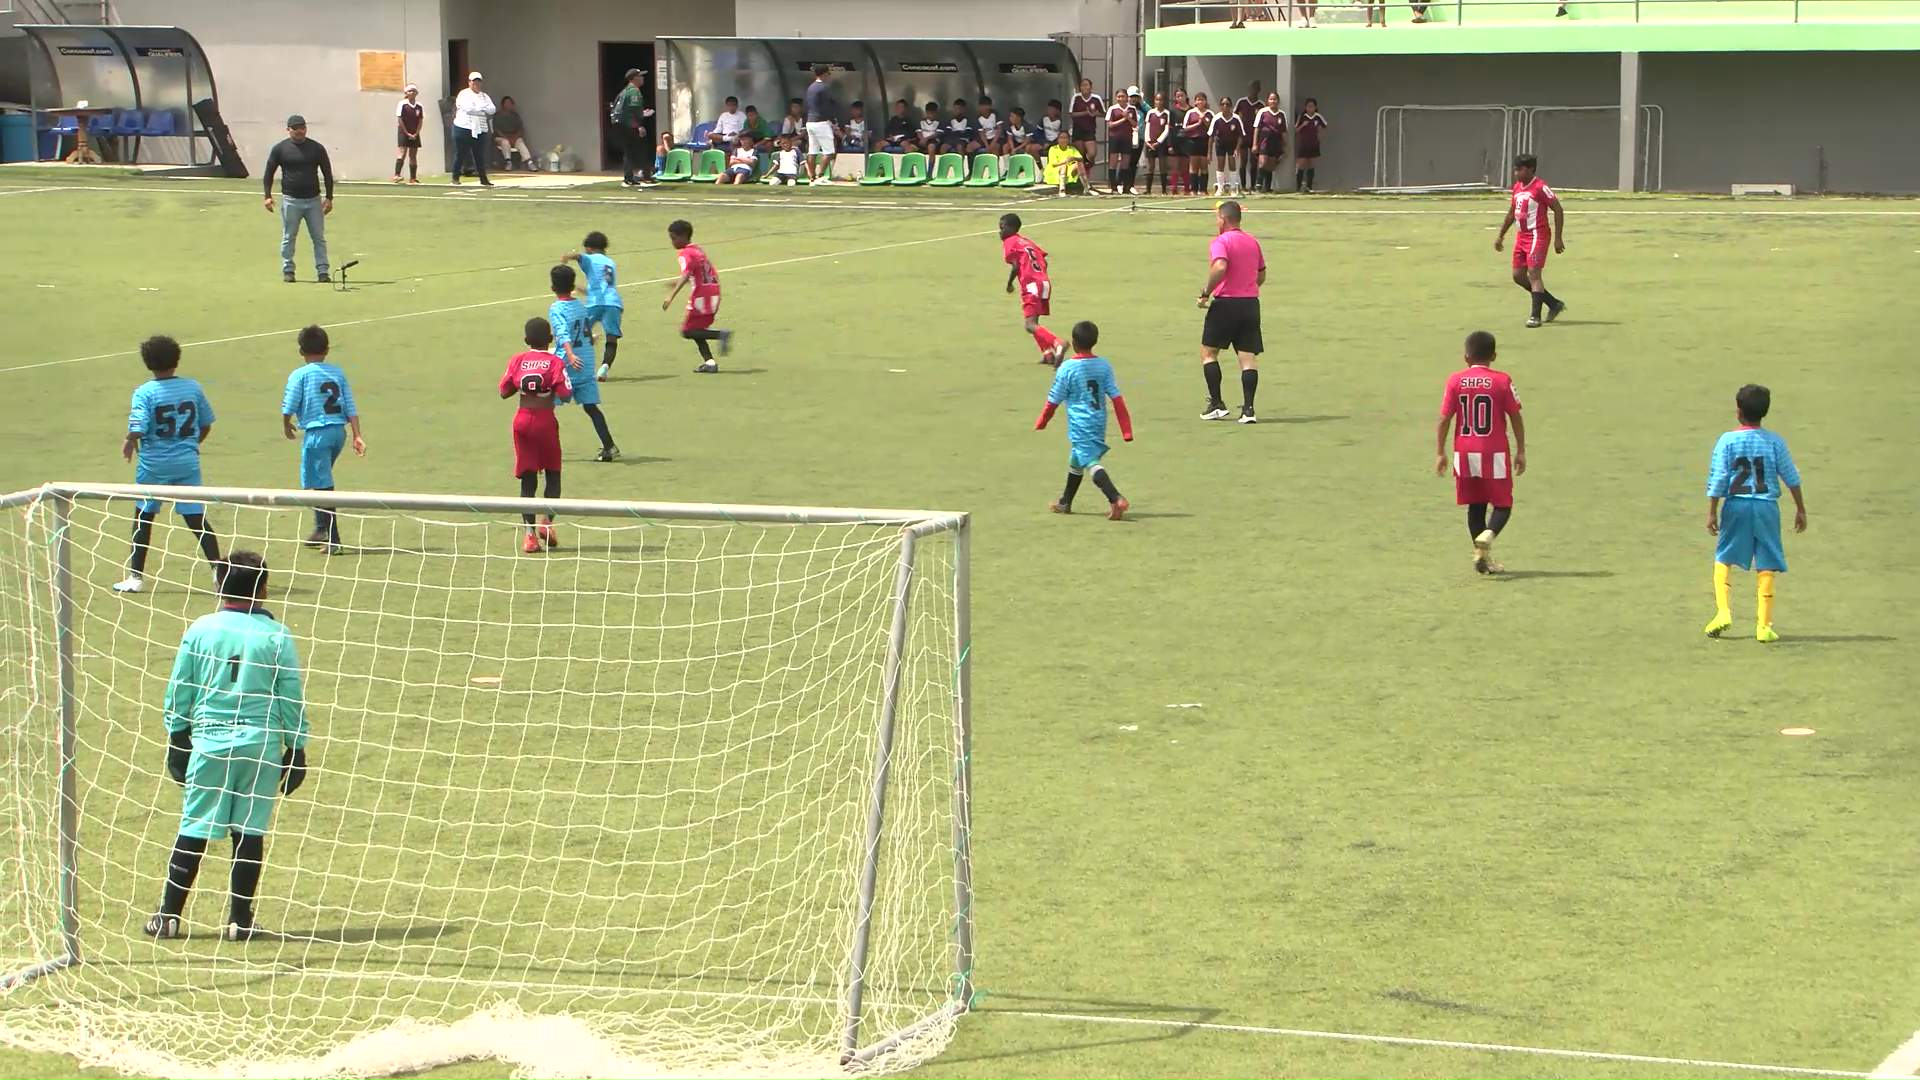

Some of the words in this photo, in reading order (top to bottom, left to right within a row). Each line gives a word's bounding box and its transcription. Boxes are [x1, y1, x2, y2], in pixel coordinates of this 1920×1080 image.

[521, 360, 550, 370] SHPS
[320, 381, 341, 414] 2
[1460, 377, 1492, 389] SHPS
[155, 401, 196, 438] 52
[1459, 394, 1492, 436] 10
[1729, 456, 1769, 494] 21
[227, 655, 240, 683] 1
